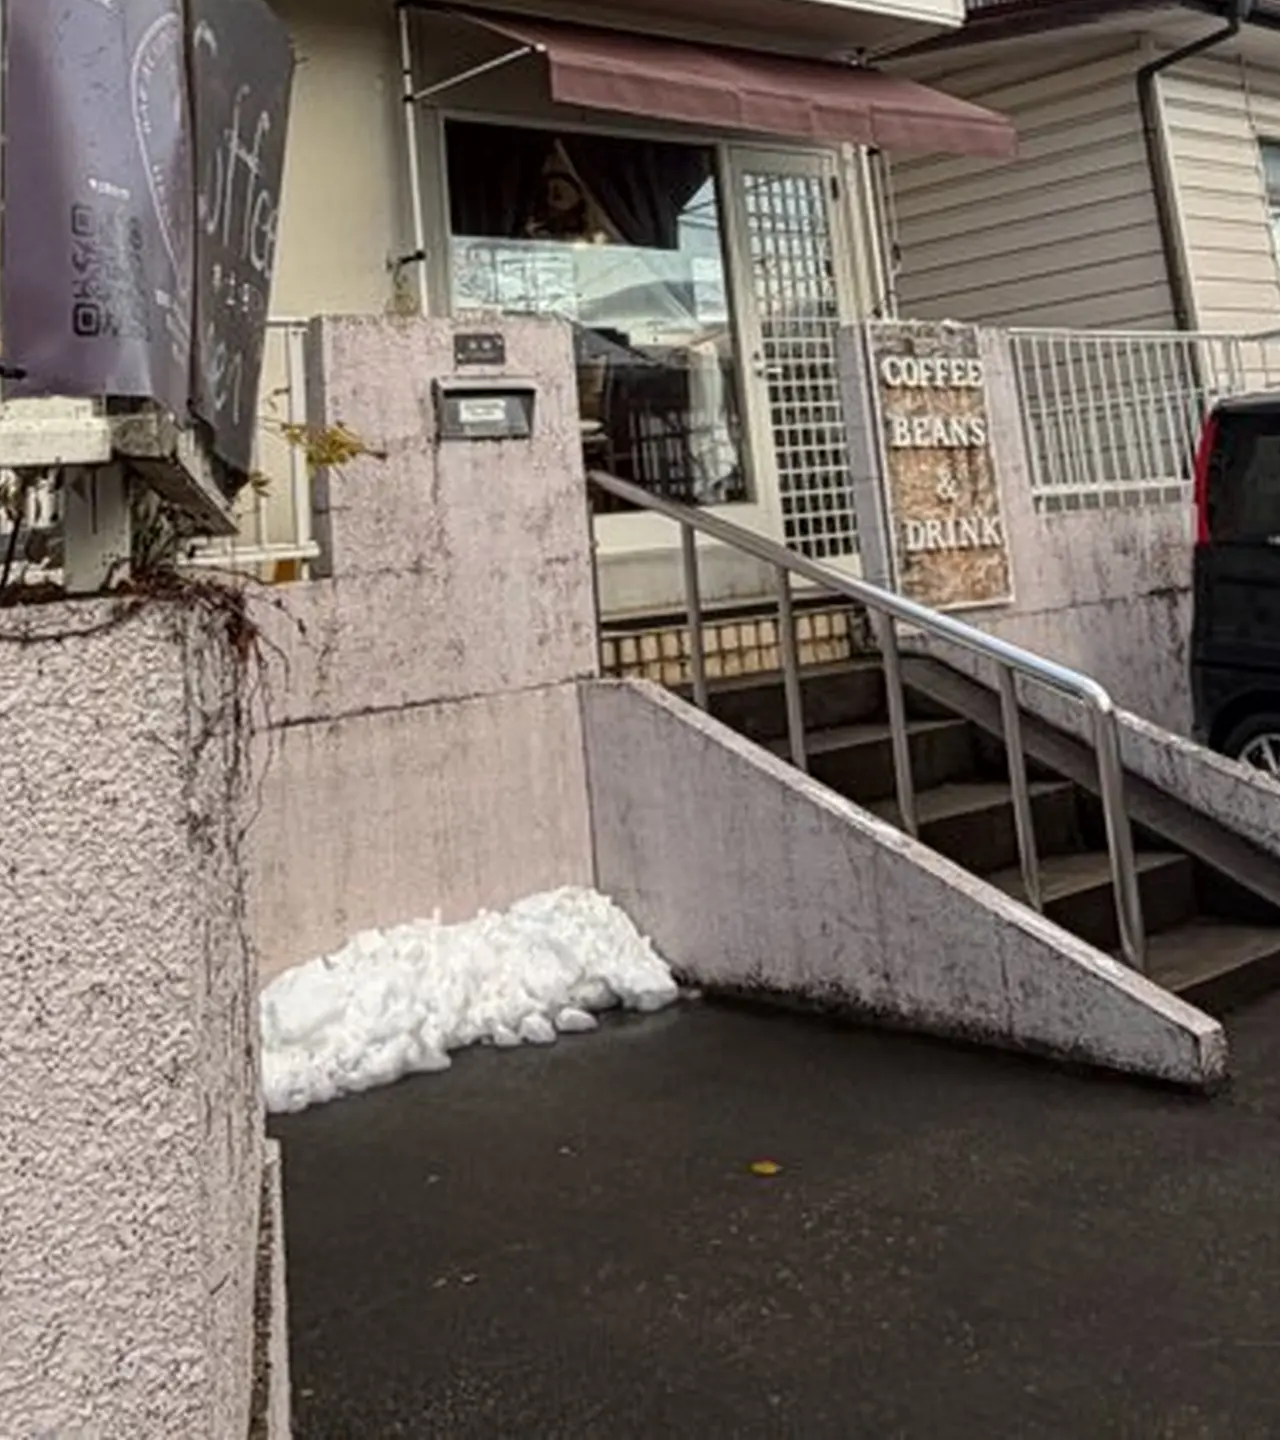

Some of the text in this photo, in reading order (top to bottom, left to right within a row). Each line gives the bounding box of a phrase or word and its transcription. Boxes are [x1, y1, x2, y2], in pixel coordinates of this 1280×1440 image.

[882, 356, 984, 389] COFFEE
[890, 415, 986, 448] BEANS
[936, 467, 958, 501] &
[906, 514, 1003, 551] DRINK
